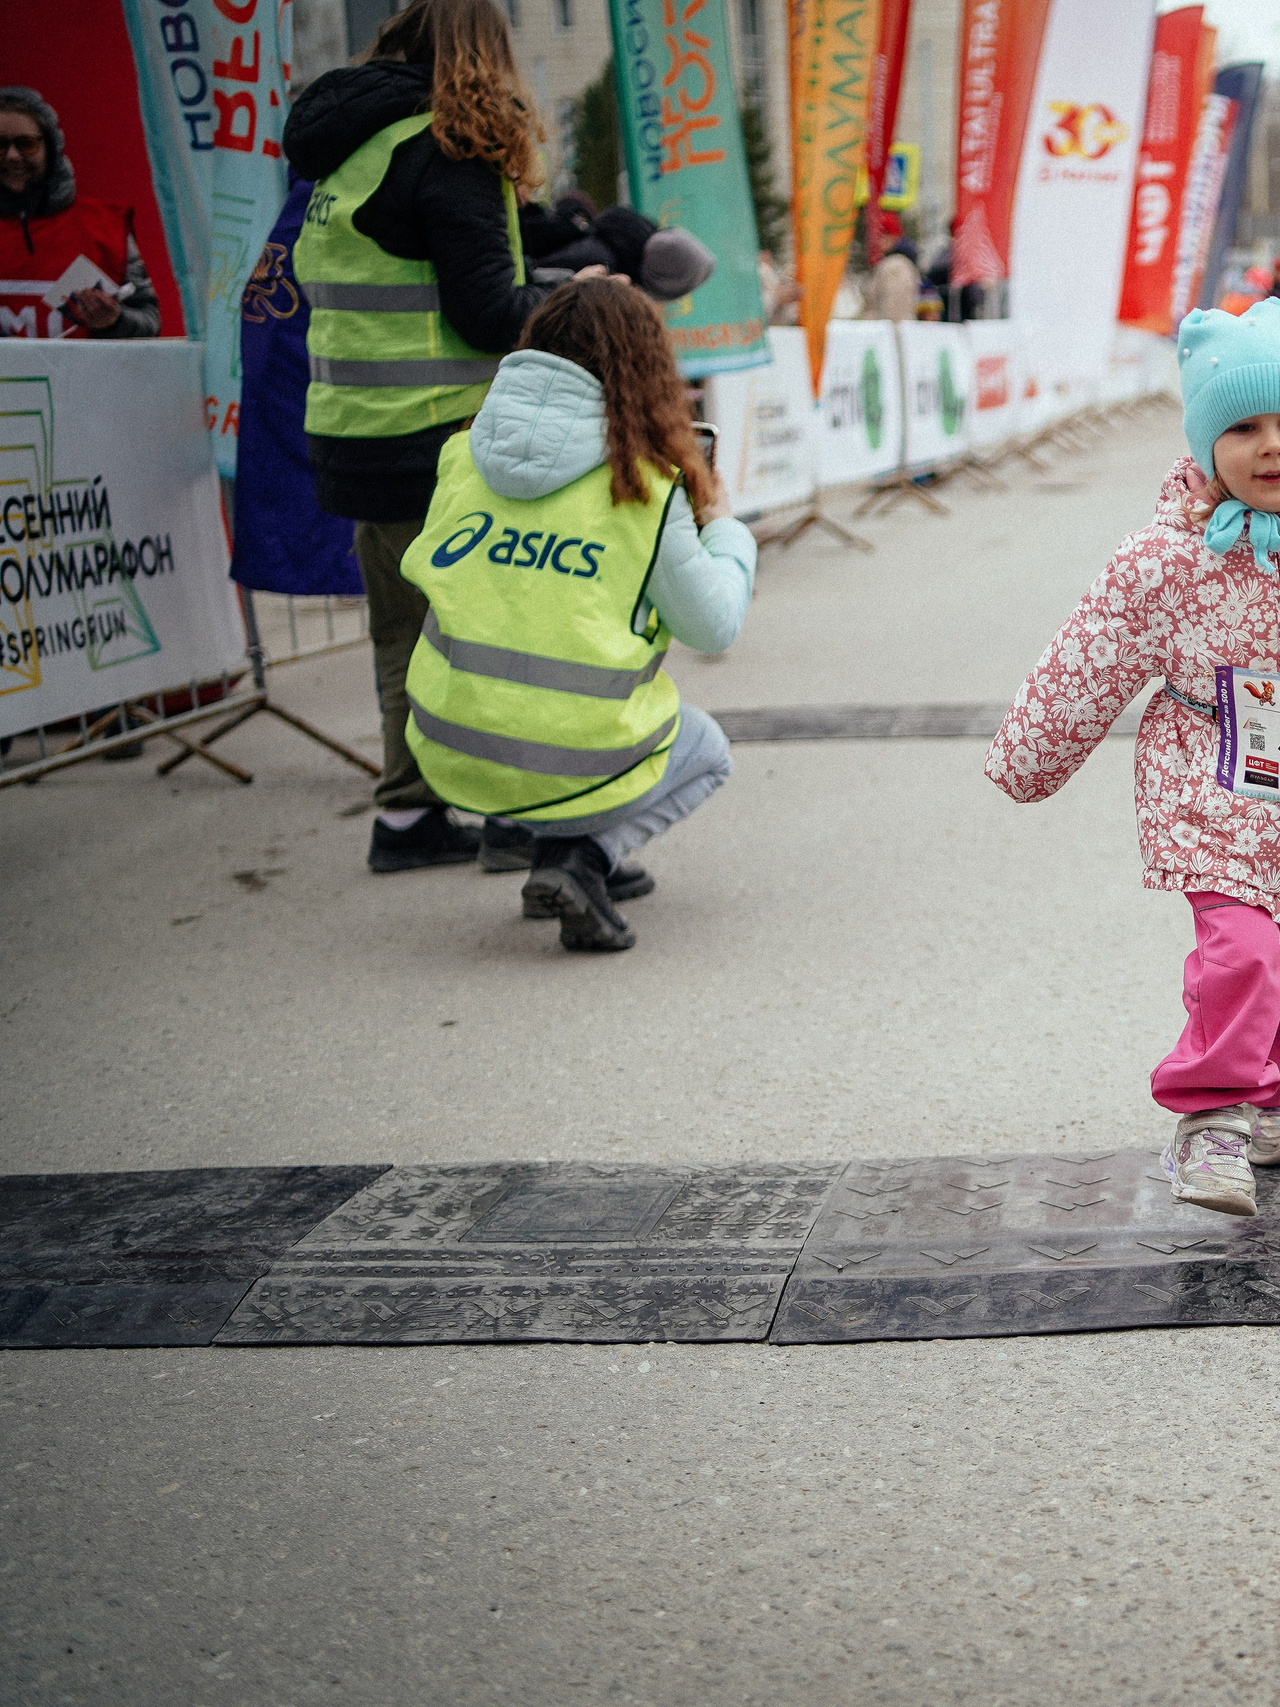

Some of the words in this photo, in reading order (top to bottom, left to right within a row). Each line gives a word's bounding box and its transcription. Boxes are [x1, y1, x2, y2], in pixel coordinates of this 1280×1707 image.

[158, 0, 214, 152] НОВ
[820, 0, 867, 256] ПОЛУМА
[0, 475, 112, 543] СЕННИЙ
[1221, 688, 1229, 703] 500
[1224, 713, 1232, 738] забег
[1221, 739, 1232, 777] Детский
[1248, 758, 1264, 768] ЦФТ
